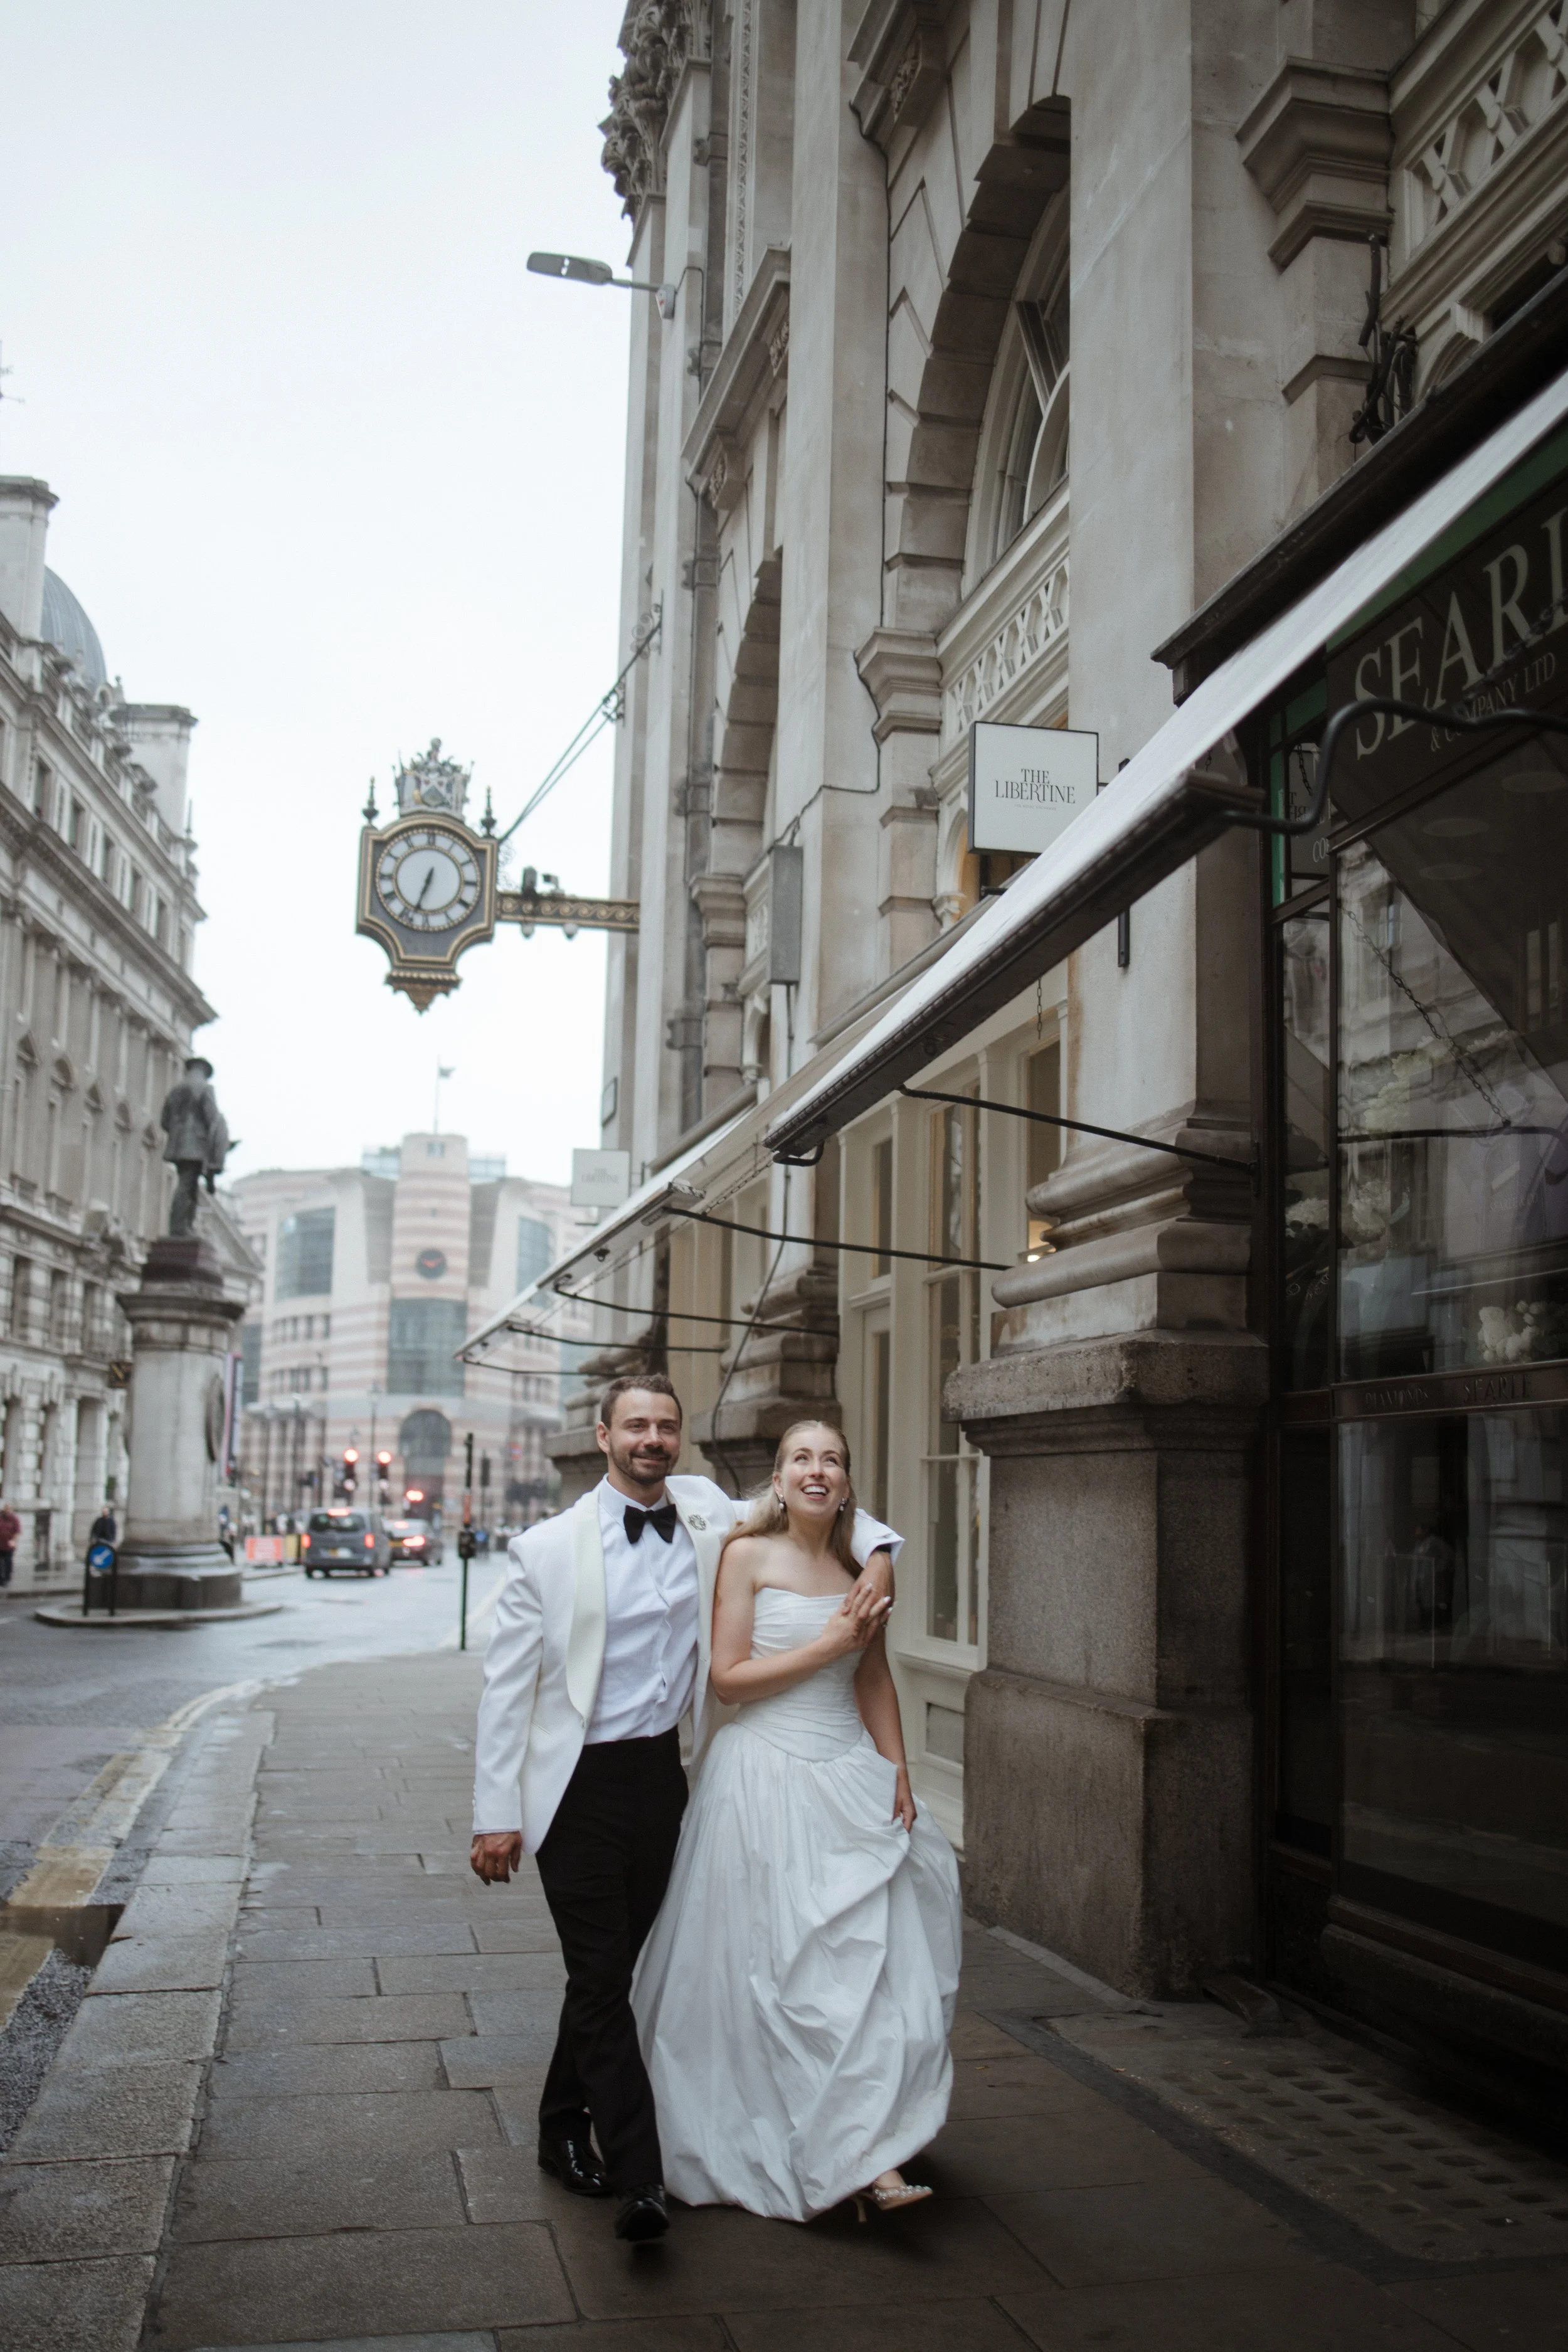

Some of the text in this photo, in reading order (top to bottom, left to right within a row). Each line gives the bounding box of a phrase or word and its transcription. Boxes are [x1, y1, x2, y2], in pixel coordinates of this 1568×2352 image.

[1523, 651, 1555, 694] LTD
[1021, 768, 1049, 784] THE
[995, 780, 1076, 803] LIBERTINE
